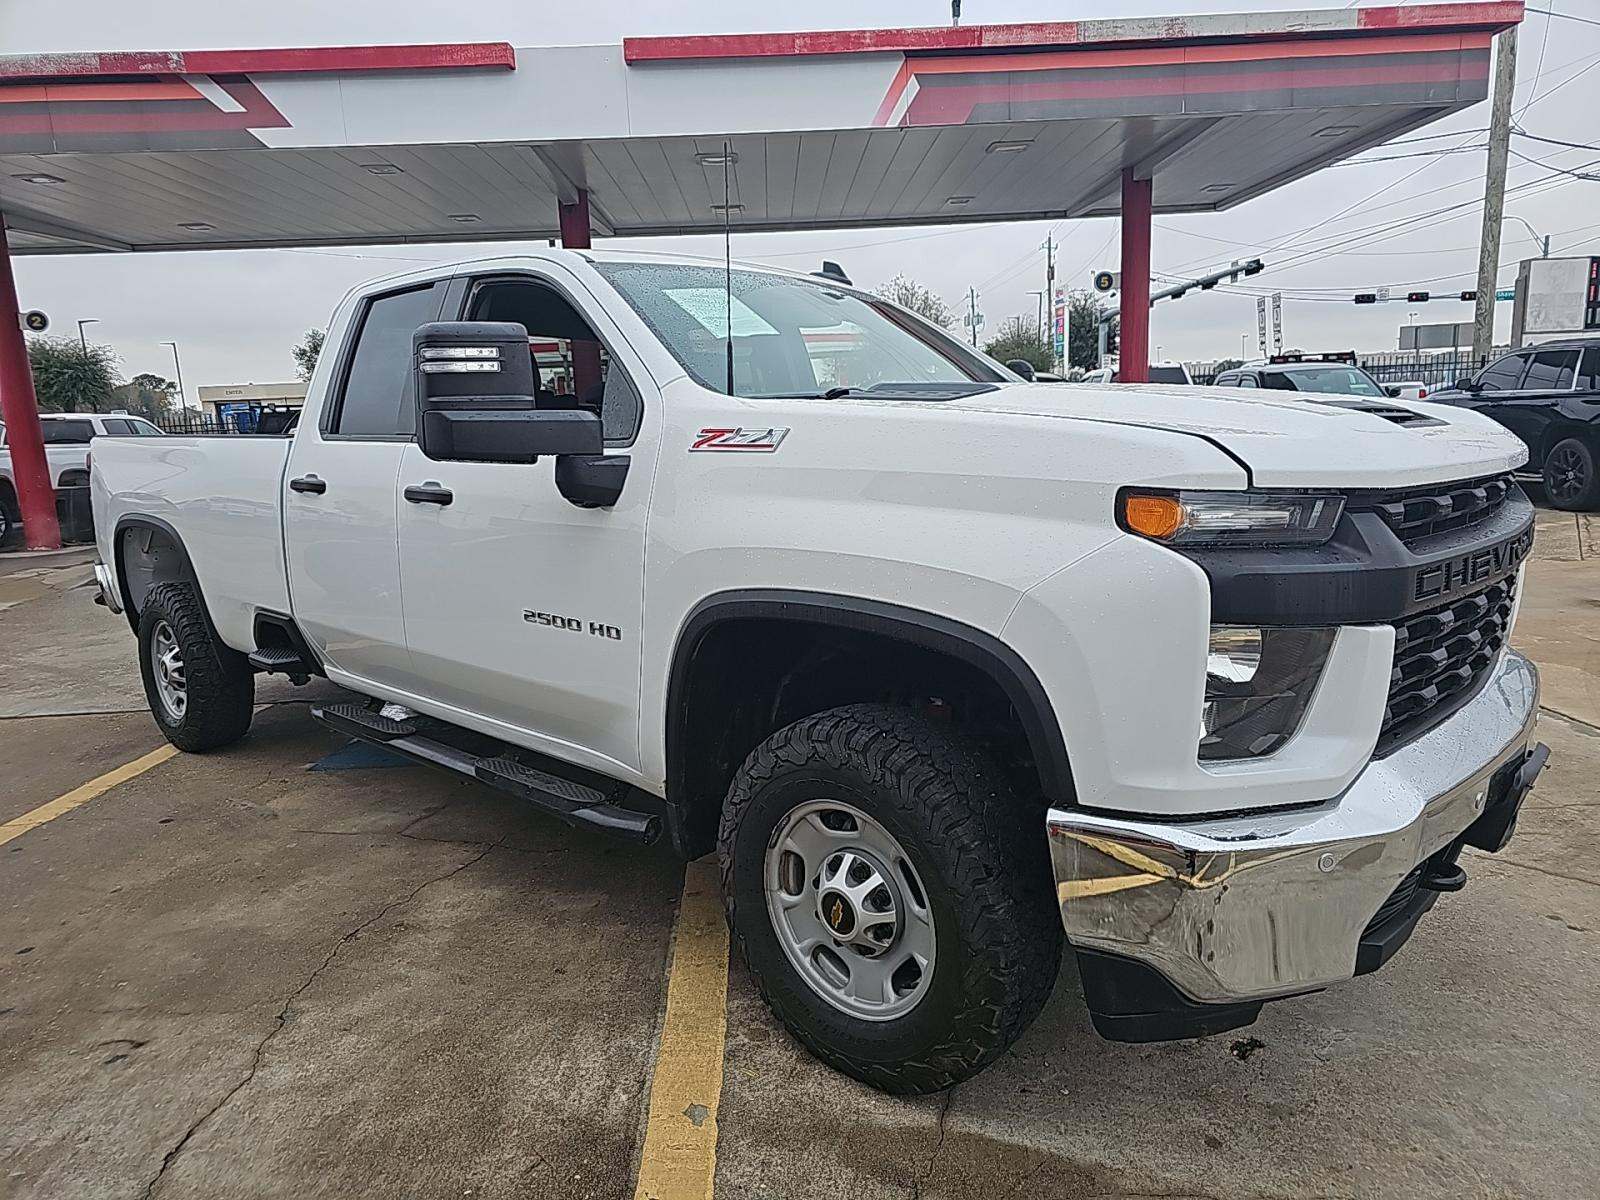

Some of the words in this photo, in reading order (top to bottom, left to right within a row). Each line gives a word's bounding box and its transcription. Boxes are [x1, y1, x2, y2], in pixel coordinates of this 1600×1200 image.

[688, 427, 791, 453] Z71
[523, 609, 582, 632] 2500
[589, 621, 621, 641] HD
